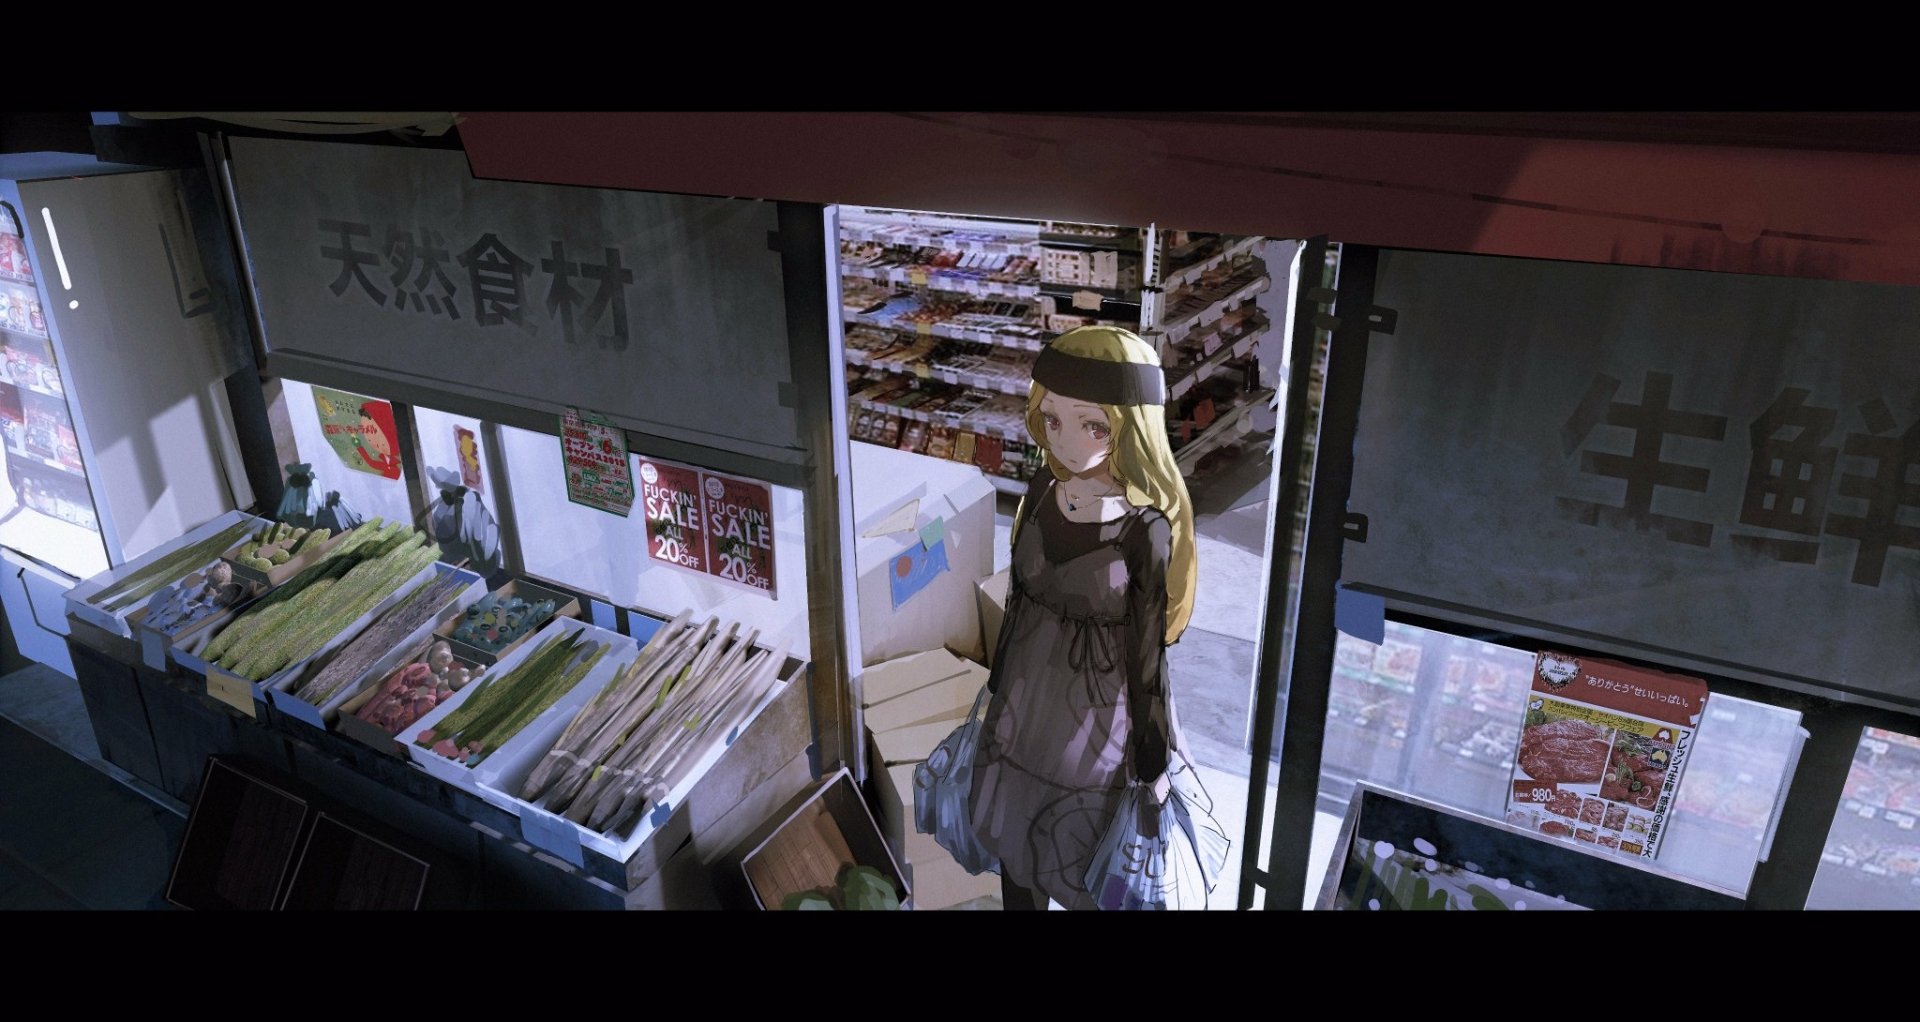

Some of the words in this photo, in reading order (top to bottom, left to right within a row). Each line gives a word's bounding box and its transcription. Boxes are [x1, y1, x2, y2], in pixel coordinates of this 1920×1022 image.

[318, 217, 635, 351] 天然食材
[644, 484, 696, 507] FUCKIN'
[646, 497, 699, 530] SALE
[709, 499, 768, 525] FUCKIN'
[665, 525, 683, 540] ALL
[711, 513, 771, 550] SALE
[679, 554, 699, 568] OFF
[732, 544, 752, 559] ALL
[747, 574, 769, 589] OFF
